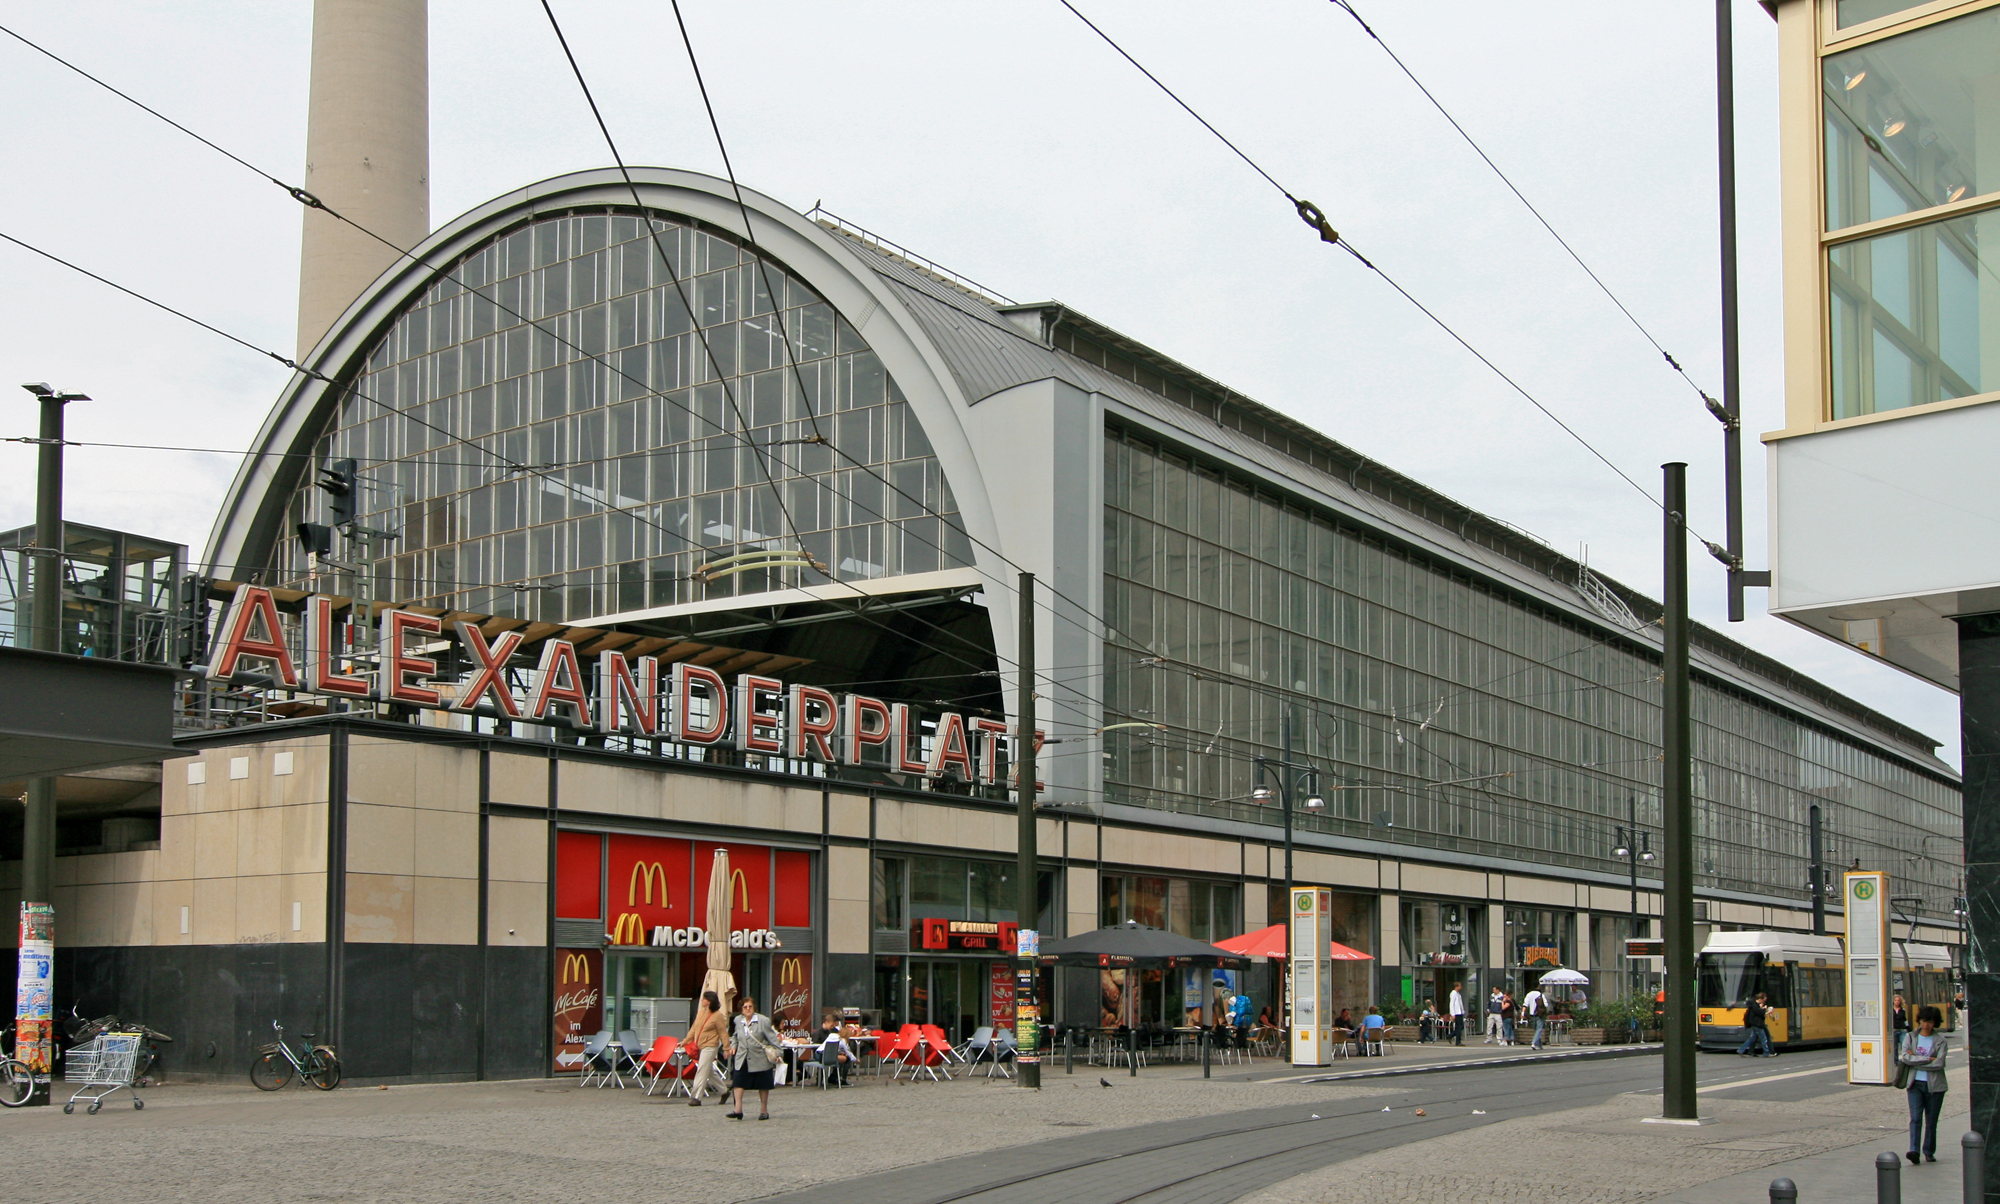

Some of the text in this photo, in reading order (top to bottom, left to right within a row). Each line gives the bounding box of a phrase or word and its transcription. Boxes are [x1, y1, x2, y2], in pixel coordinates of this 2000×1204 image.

[962, 937, 987, 948] GRILL
[1526, 946, 1559, 966] BIERBAR
[555, 989, 598, 1014] McCafé
[774, 989, 808, 1011] McCafé
[570, 1020, 581, 1030] im
[789, 1017, 802, 1026] der
